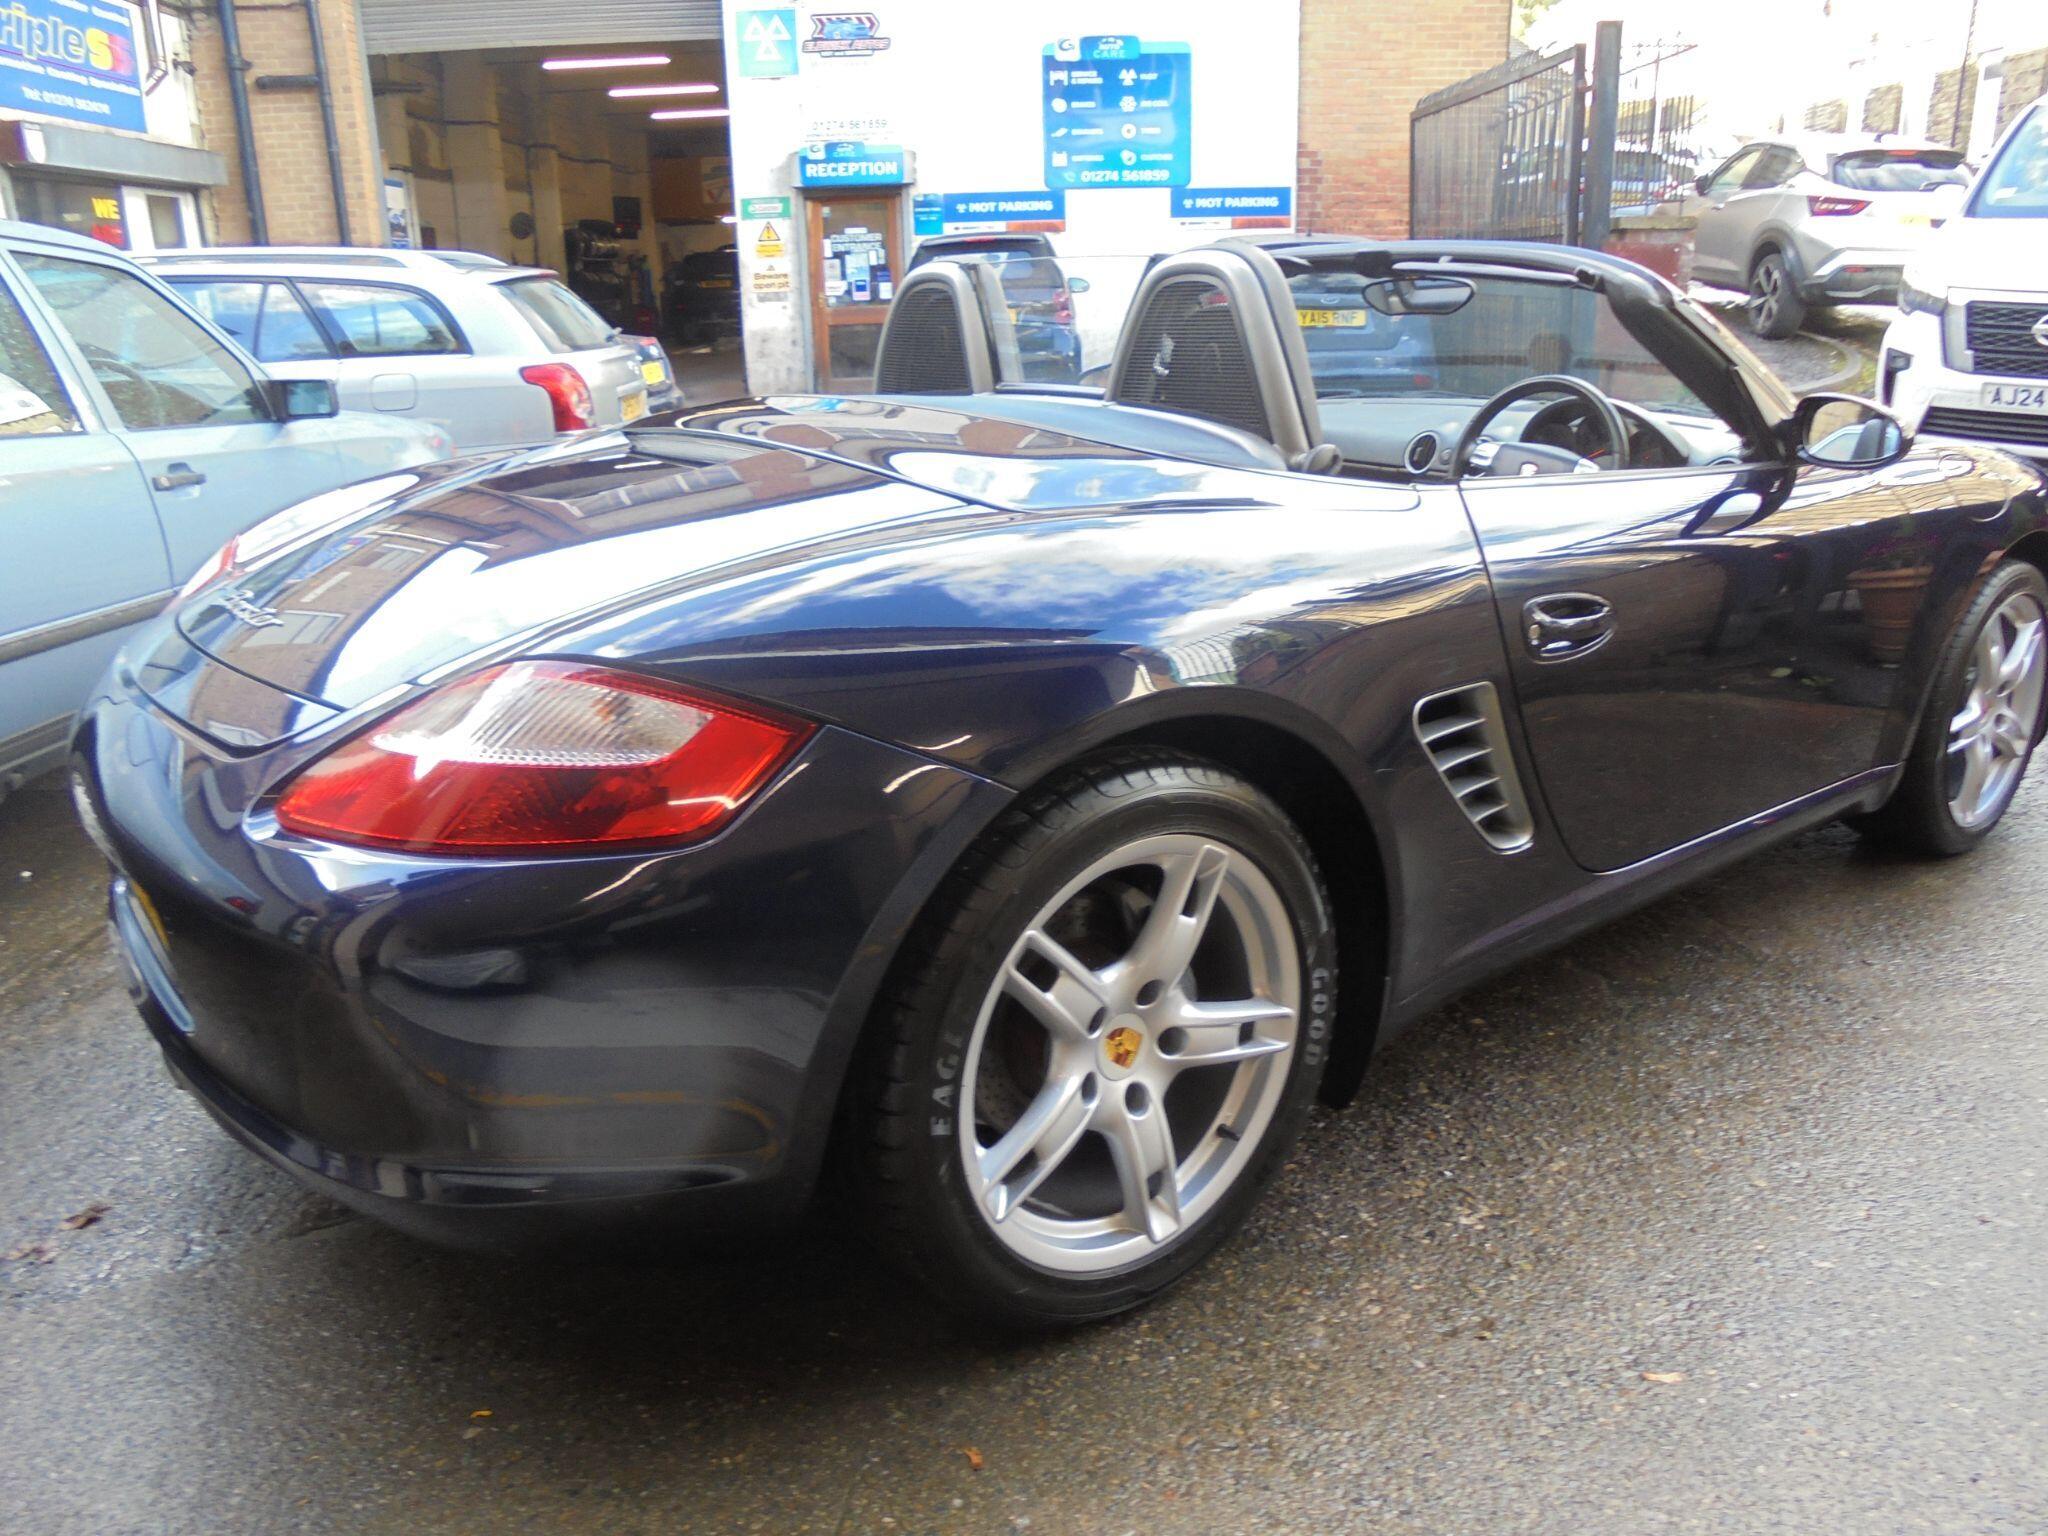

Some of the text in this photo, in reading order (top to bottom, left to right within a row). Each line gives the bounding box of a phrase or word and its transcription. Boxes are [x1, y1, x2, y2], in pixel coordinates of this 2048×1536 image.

[1092, 49, 1126, 59] CARE
[805, 161, 898, 178] RECEPTION
[1080, 170, 1119, 182] 01274
[998, 201, 1053, 212] PARKING
[1225, 197, 1279, 207] PARKING
[1990, 387, 2046, 408] AJ24
